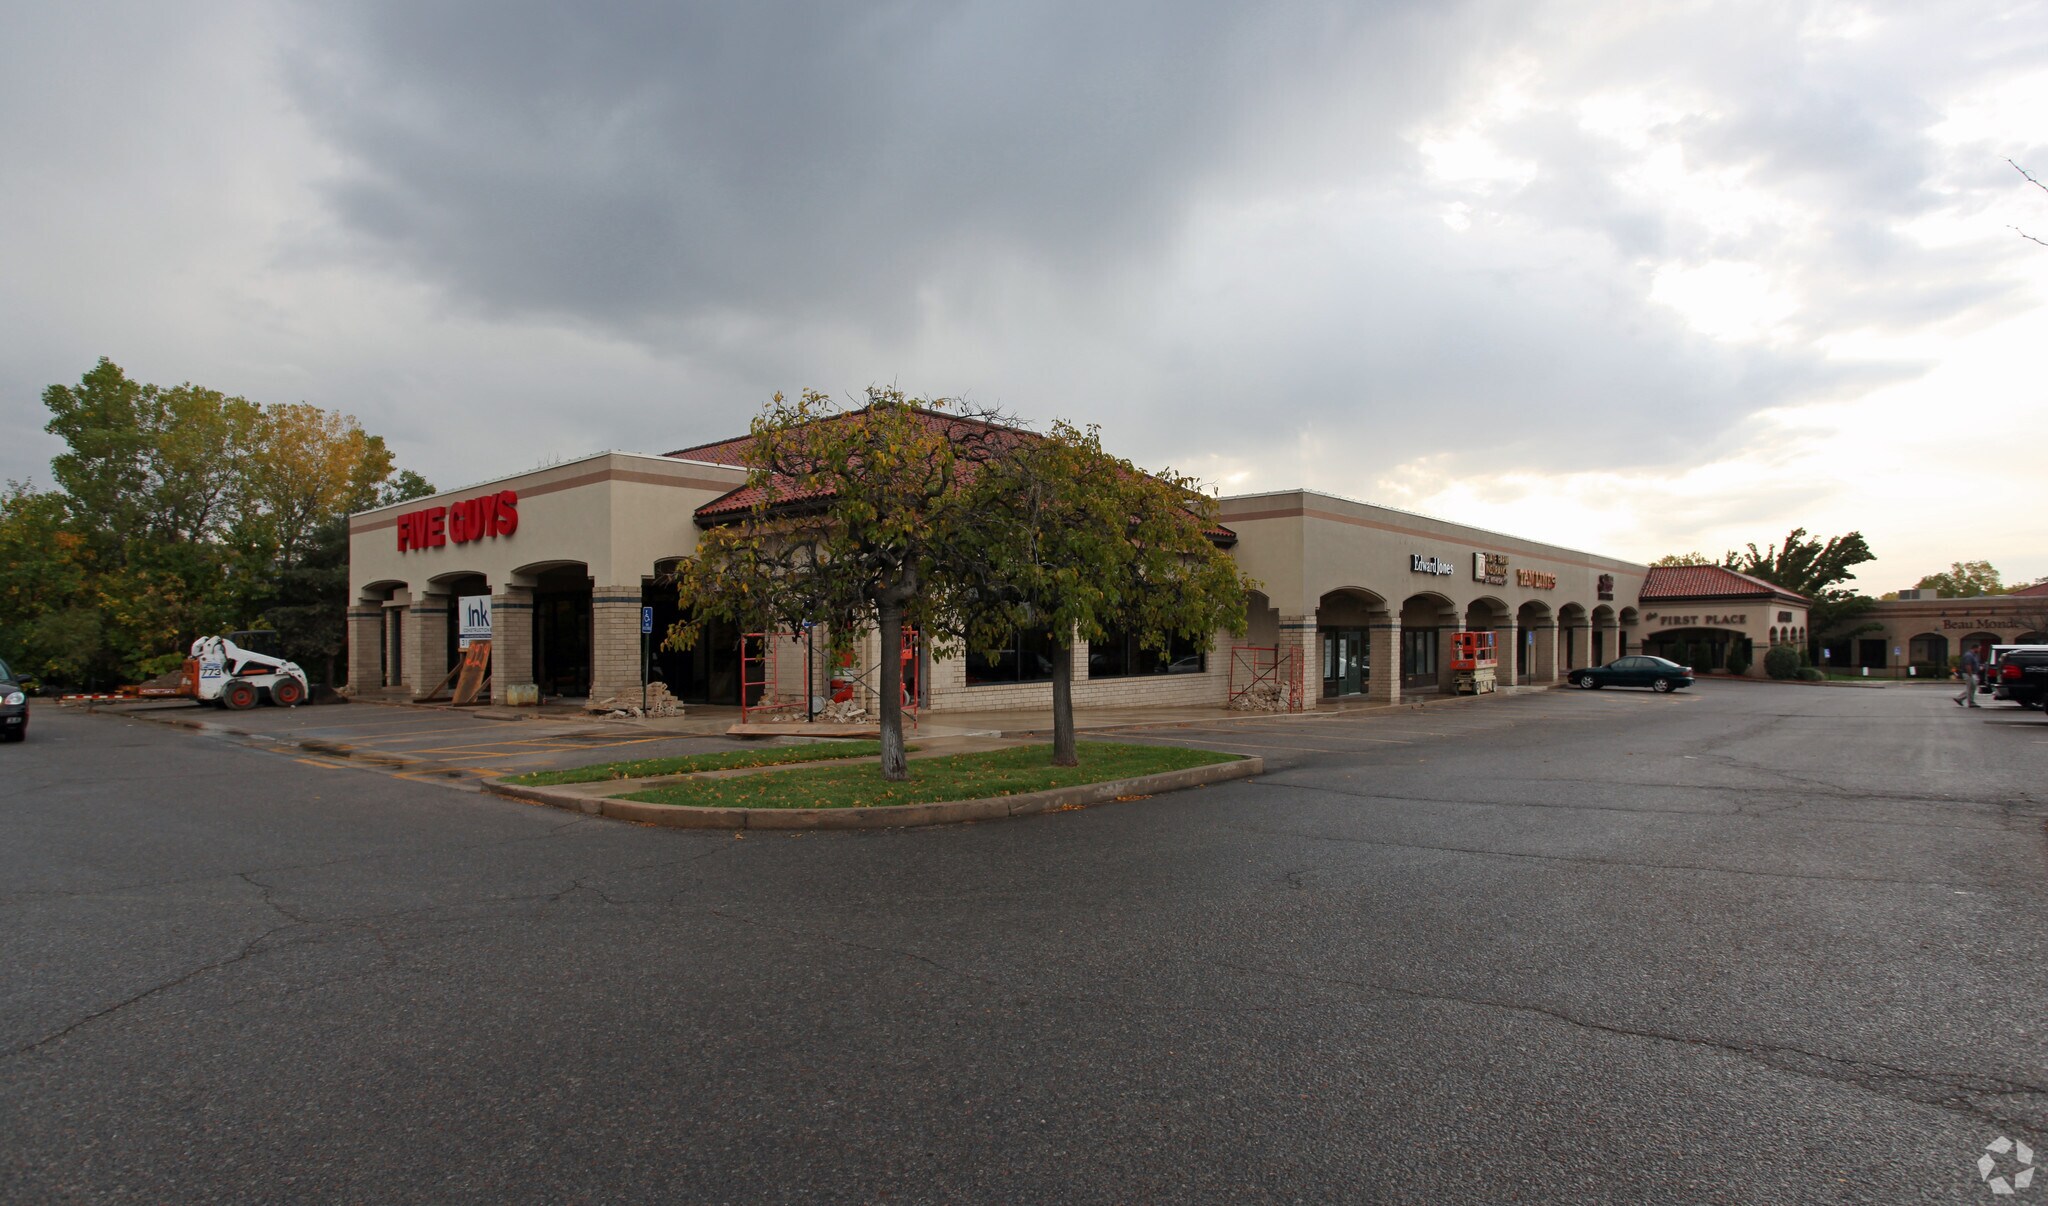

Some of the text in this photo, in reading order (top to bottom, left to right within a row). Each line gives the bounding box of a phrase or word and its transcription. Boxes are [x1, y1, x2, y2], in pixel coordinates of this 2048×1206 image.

[397, 490, 518, 552] FIVE GUYS
[1411, 554, 1454, 576] Edward Jones
[1518, 569, 1535, 587] TAN
[468, 598, 490, 627] Ink
[1660, 615, 1699, 626] FIRST
[1705, 614, 1746, 625] PLACE
[1943, 619, 1973, 629] Beau
[201, 668, 221, 677] 773
